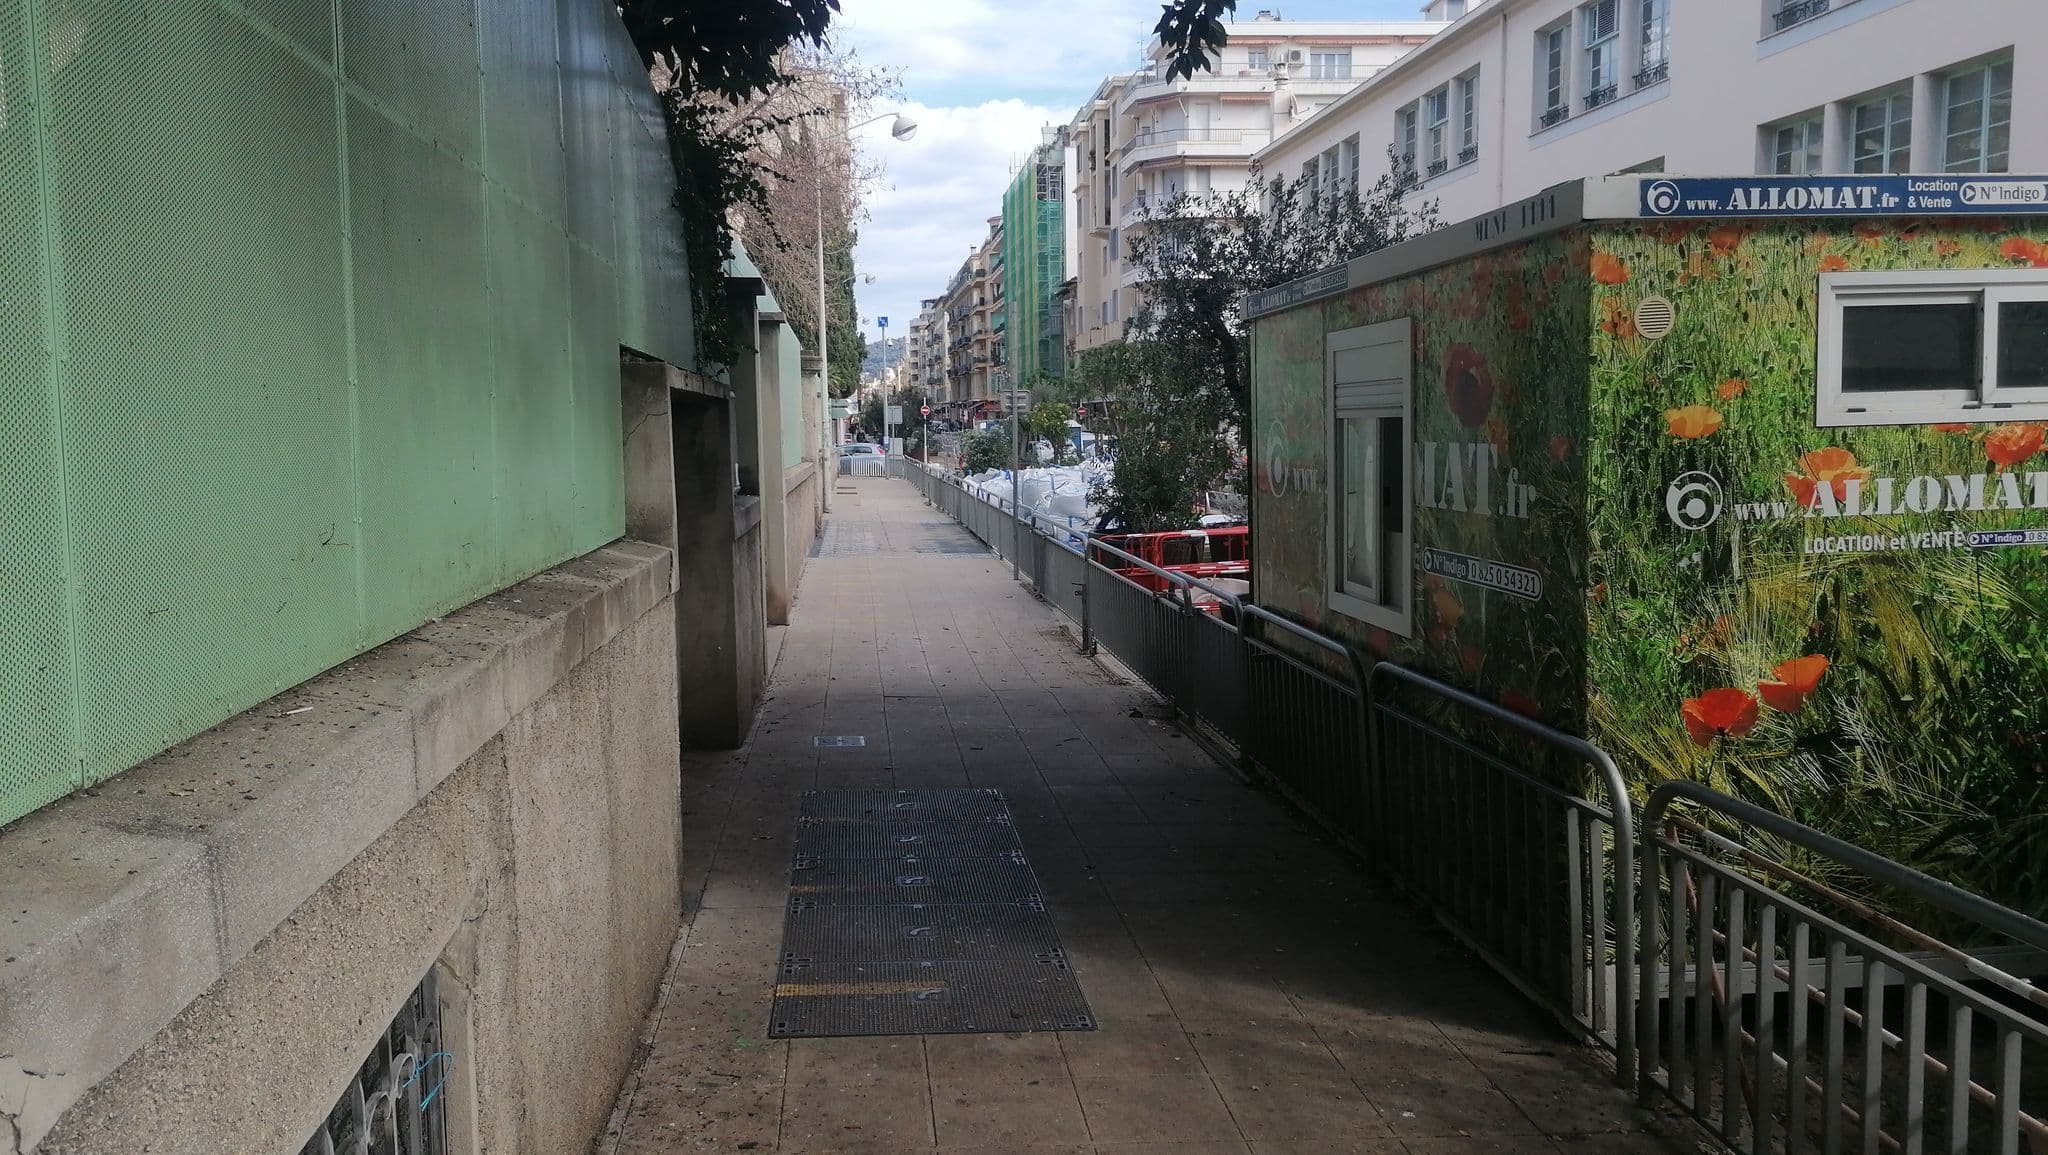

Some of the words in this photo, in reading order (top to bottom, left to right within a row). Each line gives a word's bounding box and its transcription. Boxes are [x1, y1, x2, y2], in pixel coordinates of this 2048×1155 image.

[1907, 179, 1958, 192] Location
[1685, 199, 1722, 211] www.
[1726, 186, 1900, 210] ALLOMAT.fr
[1907, 196, 1917, 208] &
[1919, 195, 1953, 208] Vente
[1999, 186, 2040, 202] Indigo
[1803, 534, 1886, 554] LOCATION
[1890, 535, 1907, 550] et
[1907, 530, 1965, 550] VENTE
[1995, 532, 2023, 544] Indigo
[1443, 556, 1467, 579] Indigo
